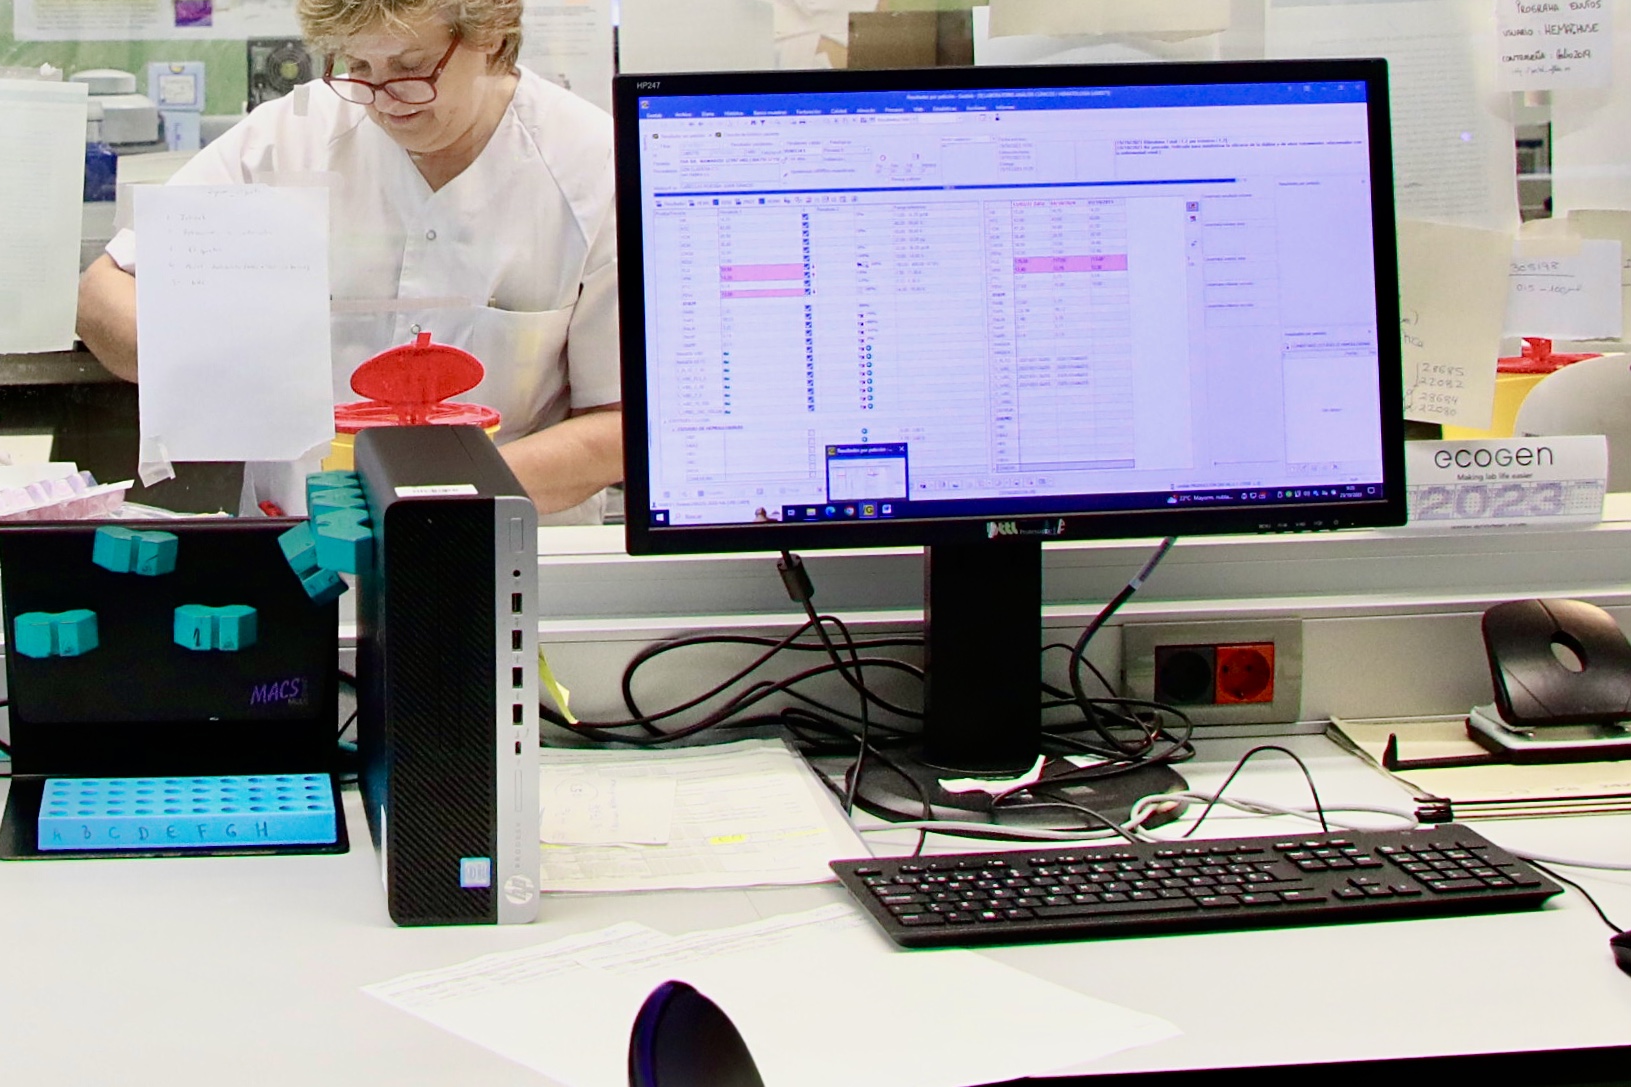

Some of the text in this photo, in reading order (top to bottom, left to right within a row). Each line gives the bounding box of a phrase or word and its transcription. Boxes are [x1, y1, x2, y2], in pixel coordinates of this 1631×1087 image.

[637, 82, 660, 90] HP247
[1434, 446, 1553, 468] ecogen
[1457, 473, 1484, 481] Making
[1420, 482, 1564, 520] 2023
[250, 678, 300, 705] MACS
[108, 826, 120, 839] C
[138, 828, 149, 840] D
[166, 825, 177, 838] E
[197, 824, 207, 838] F
[226, 824, 237, 837] G
[255, 821, 268, 837] H
